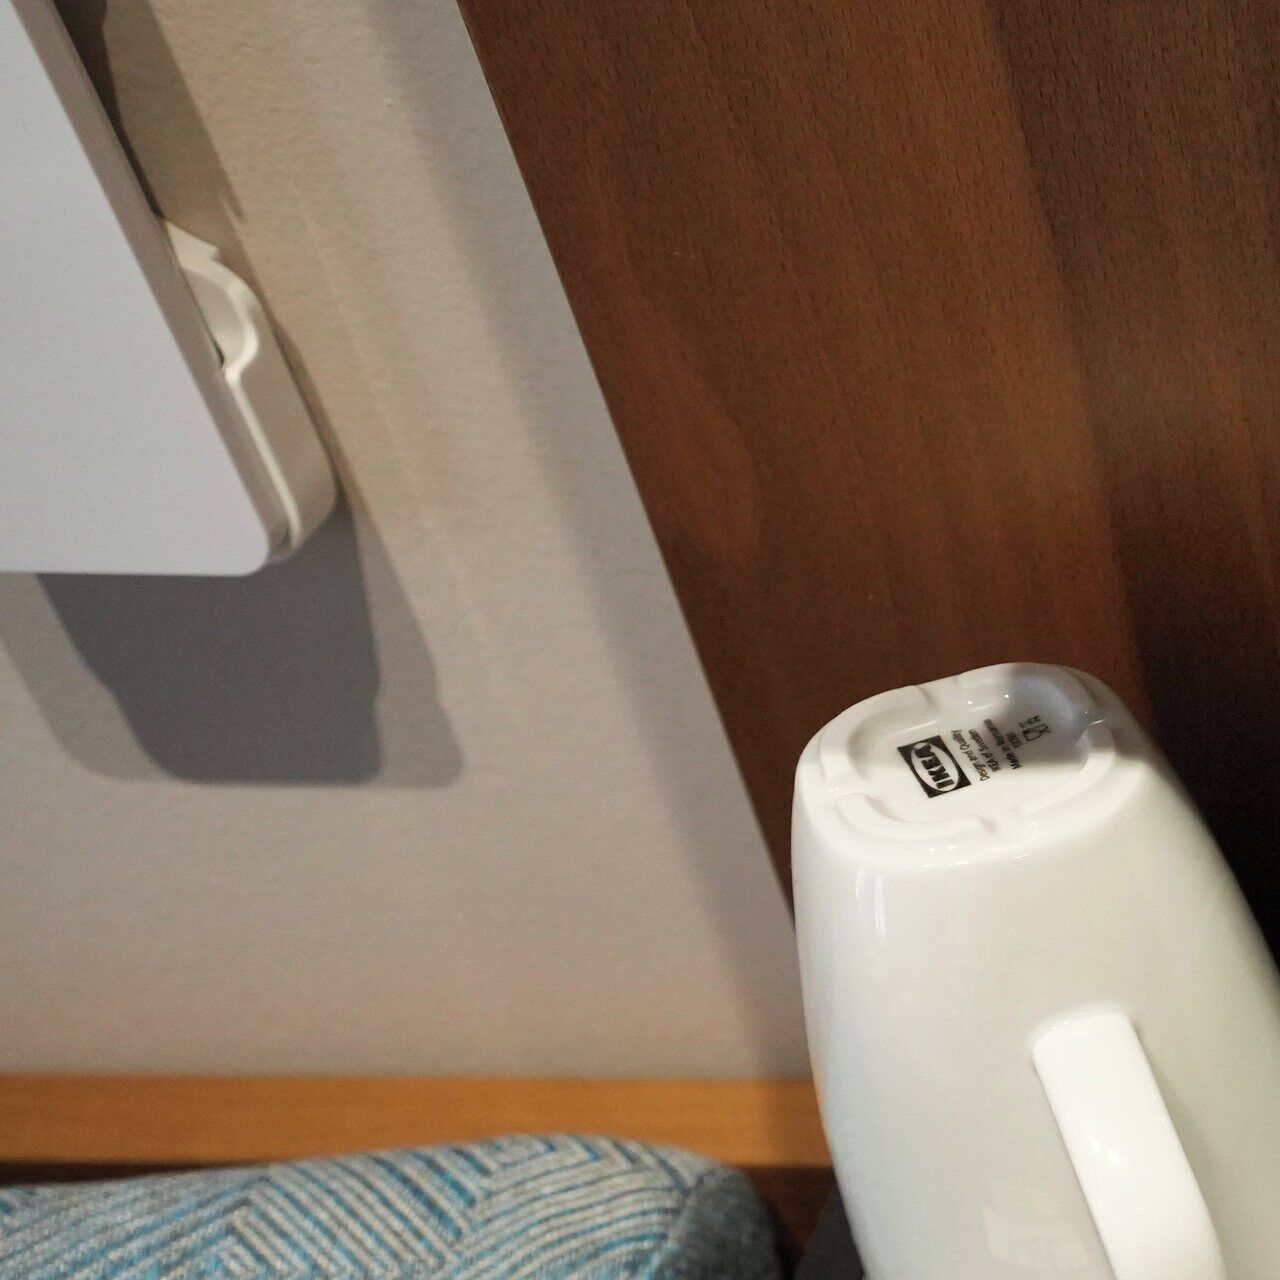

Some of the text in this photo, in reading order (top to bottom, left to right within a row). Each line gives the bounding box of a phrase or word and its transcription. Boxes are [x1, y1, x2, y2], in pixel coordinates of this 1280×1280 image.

[914, 744, 955, 789] IKEA
[972, 760, 990, 782] Design
[1005, 751, 1023, 770] Made
